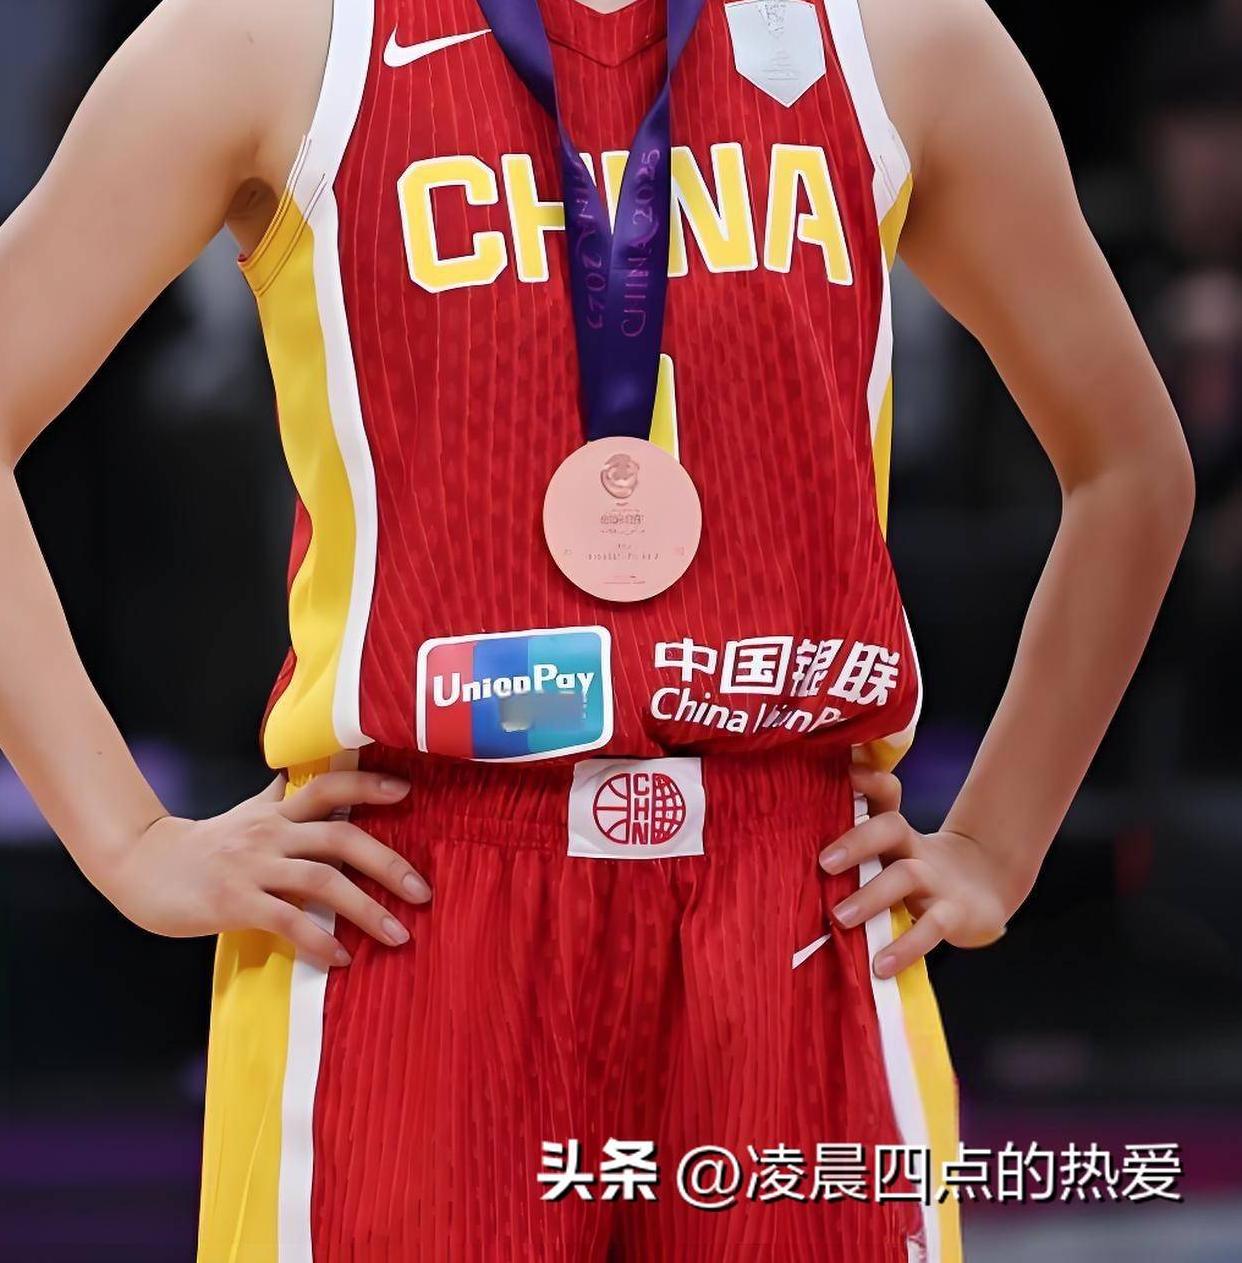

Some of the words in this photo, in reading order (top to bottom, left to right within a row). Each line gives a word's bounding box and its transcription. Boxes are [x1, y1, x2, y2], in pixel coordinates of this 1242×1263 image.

[654, 635, 902, 706] 中国银联
[650, 687, 746, 734] China
